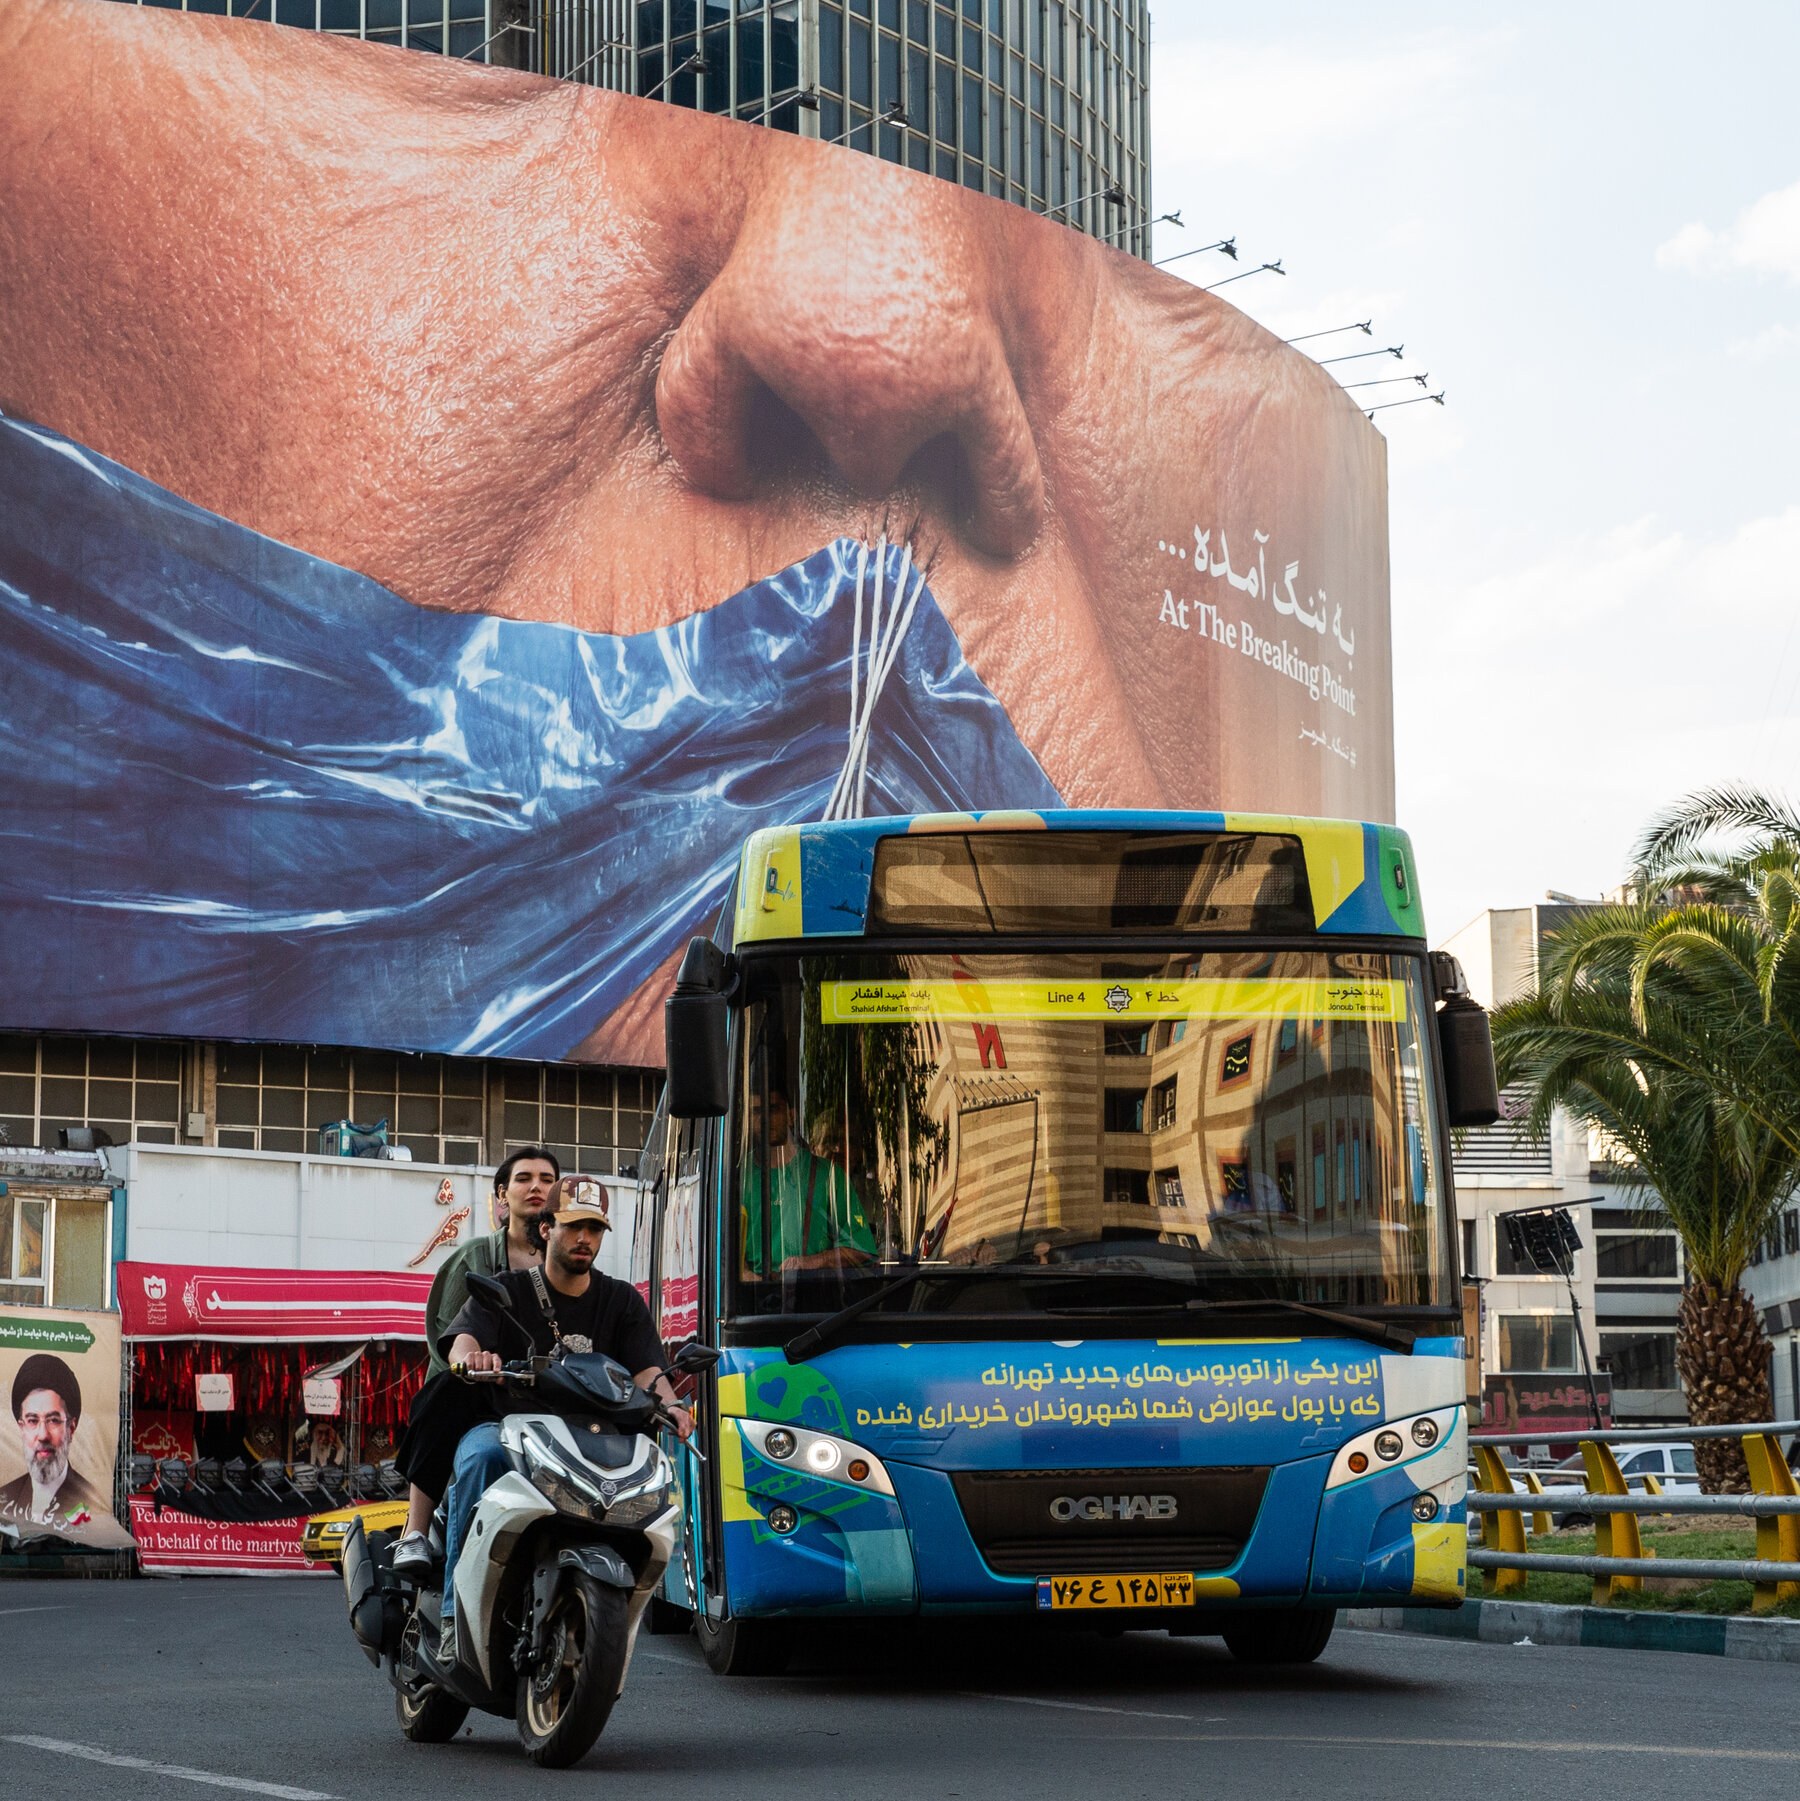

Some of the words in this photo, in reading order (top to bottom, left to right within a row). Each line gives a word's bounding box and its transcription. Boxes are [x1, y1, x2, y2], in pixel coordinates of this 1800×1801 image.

[1273, 560, 1326, 634] تنگ
[1333, 602, 1355, 671] به
[1158, 589, 1189, 630] At
[1194, 600, 1237, 649] The
[1240, 620, 1319, 701] Breaking
[1322, 664, 1356, 716] Point
[851, 987, 883, 1001] افشار
[885, 990, 907, 1001] شهید
[1047, 991, 1074, 1003] Line
[1077, 991, 1086, 1003] 4
[1145, 990, 1153, 1003] ۴
[1157, 991, 1179, 1002] خط
[1327, 987, 1363, 1000] جنوب
[851, 1005, 875, 1013] Shahid
[876, 1005, 898, 1013] Afshar
[900, 1004, 930, 1013] Terminal
[1328, 1003, 1354, 1011] Jonoub
[1355, 1003, 1385, 1012] Terminal
[23, 1328, 42, 1340] نیابت
[42, 1330, 49, 1340] به
[981, 1363, 1054, 1392] تهرانه
[1060, 1366, 1120, 1389] جدید
[1273, 1359, 1289, 1384] از
[1294, 1358, 1339, 1386] یکی
[1344, 1358, 1379, 1384] این
[857, 1402, 913, 1426] شده
[918, 1398, 1009, 1429] خریداری
[1015, 1397, 1138, 1427] شهروندان
[1143, 1396, 1193, 1419] شما
[1199, 1393, 1277, 1424] عوارض
[1282, 1395, 1325, 1426] پول
[1329, 1395, 1345, 1422] با
[1350, 1393, 1381, 1415] که
[1049, 1495, 1178, 1521] OGHAB
[156, 1533, 201, 1550] behalf
[204, 1535, 219, 1551] of
[222, 1535, 243, 1551] the
[246, 1538, 301, 1557] martyrs
[1054, 1580, 1083, 1605] ۷۶
[1089, 1580, 1109, 1604] ع
[1115, 1578, 1158, 1604] ۱۴۵
[1163, 1582, 1191, 1604] ۳۳
